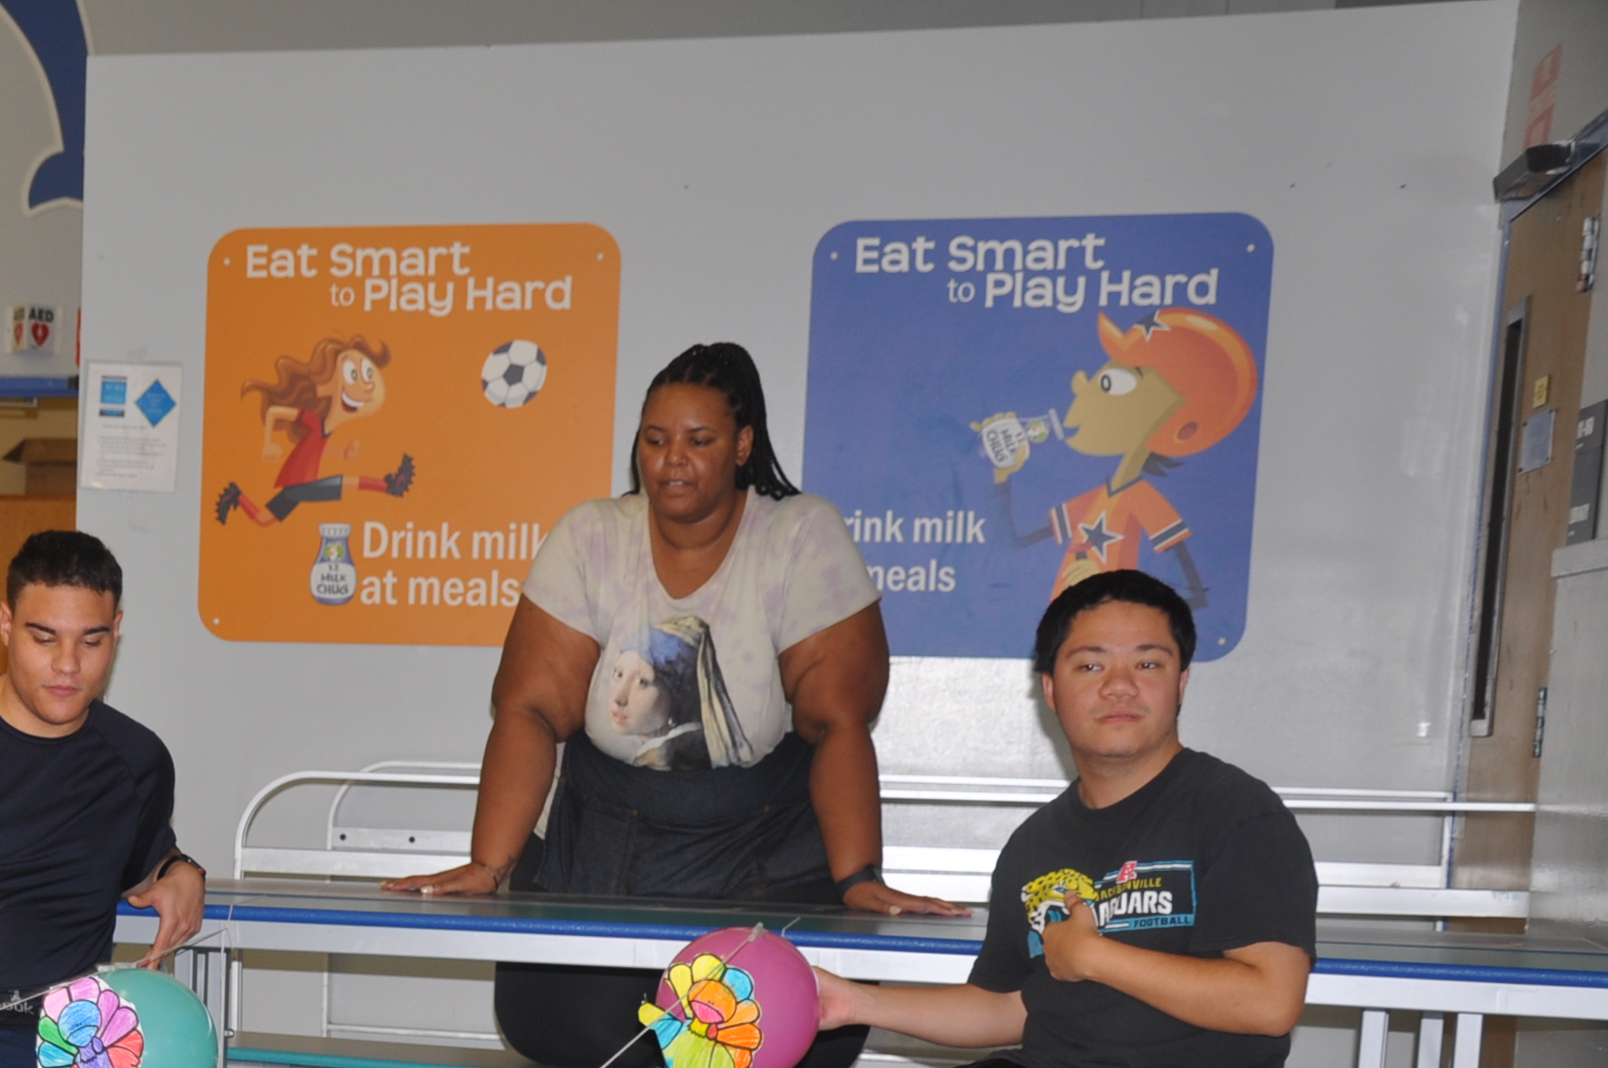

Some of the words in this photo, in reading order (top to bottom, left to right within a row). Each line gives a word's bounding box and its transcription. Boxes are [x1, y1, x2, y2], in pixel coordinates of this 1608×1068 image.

[246, 243, 318, 278] Eat
[329, 241, 471, 277] Smart
[855, 236, 935, 273] Eat
[947, 233, 1105, 272] Smart
[329, 283, 355, 307] to
[364, 277, 454, 317] Play
[466, 275, 572, 311] Hard
[947, 278, 975, 303] to
[984, 271, 1086, 314] Play
[1098, 268, 1219, 307] Hard
[28, 307, 54, 323] AED
[363, 521, 461, 559] Drink
[913, 510, 986, 544] milk
[316, 583, 349, 595] CHUG
[360, 569, 398, 605] at
[407, 569, 521, 607] meals
[1133, 915, 1191, 928] FOOTBALL
